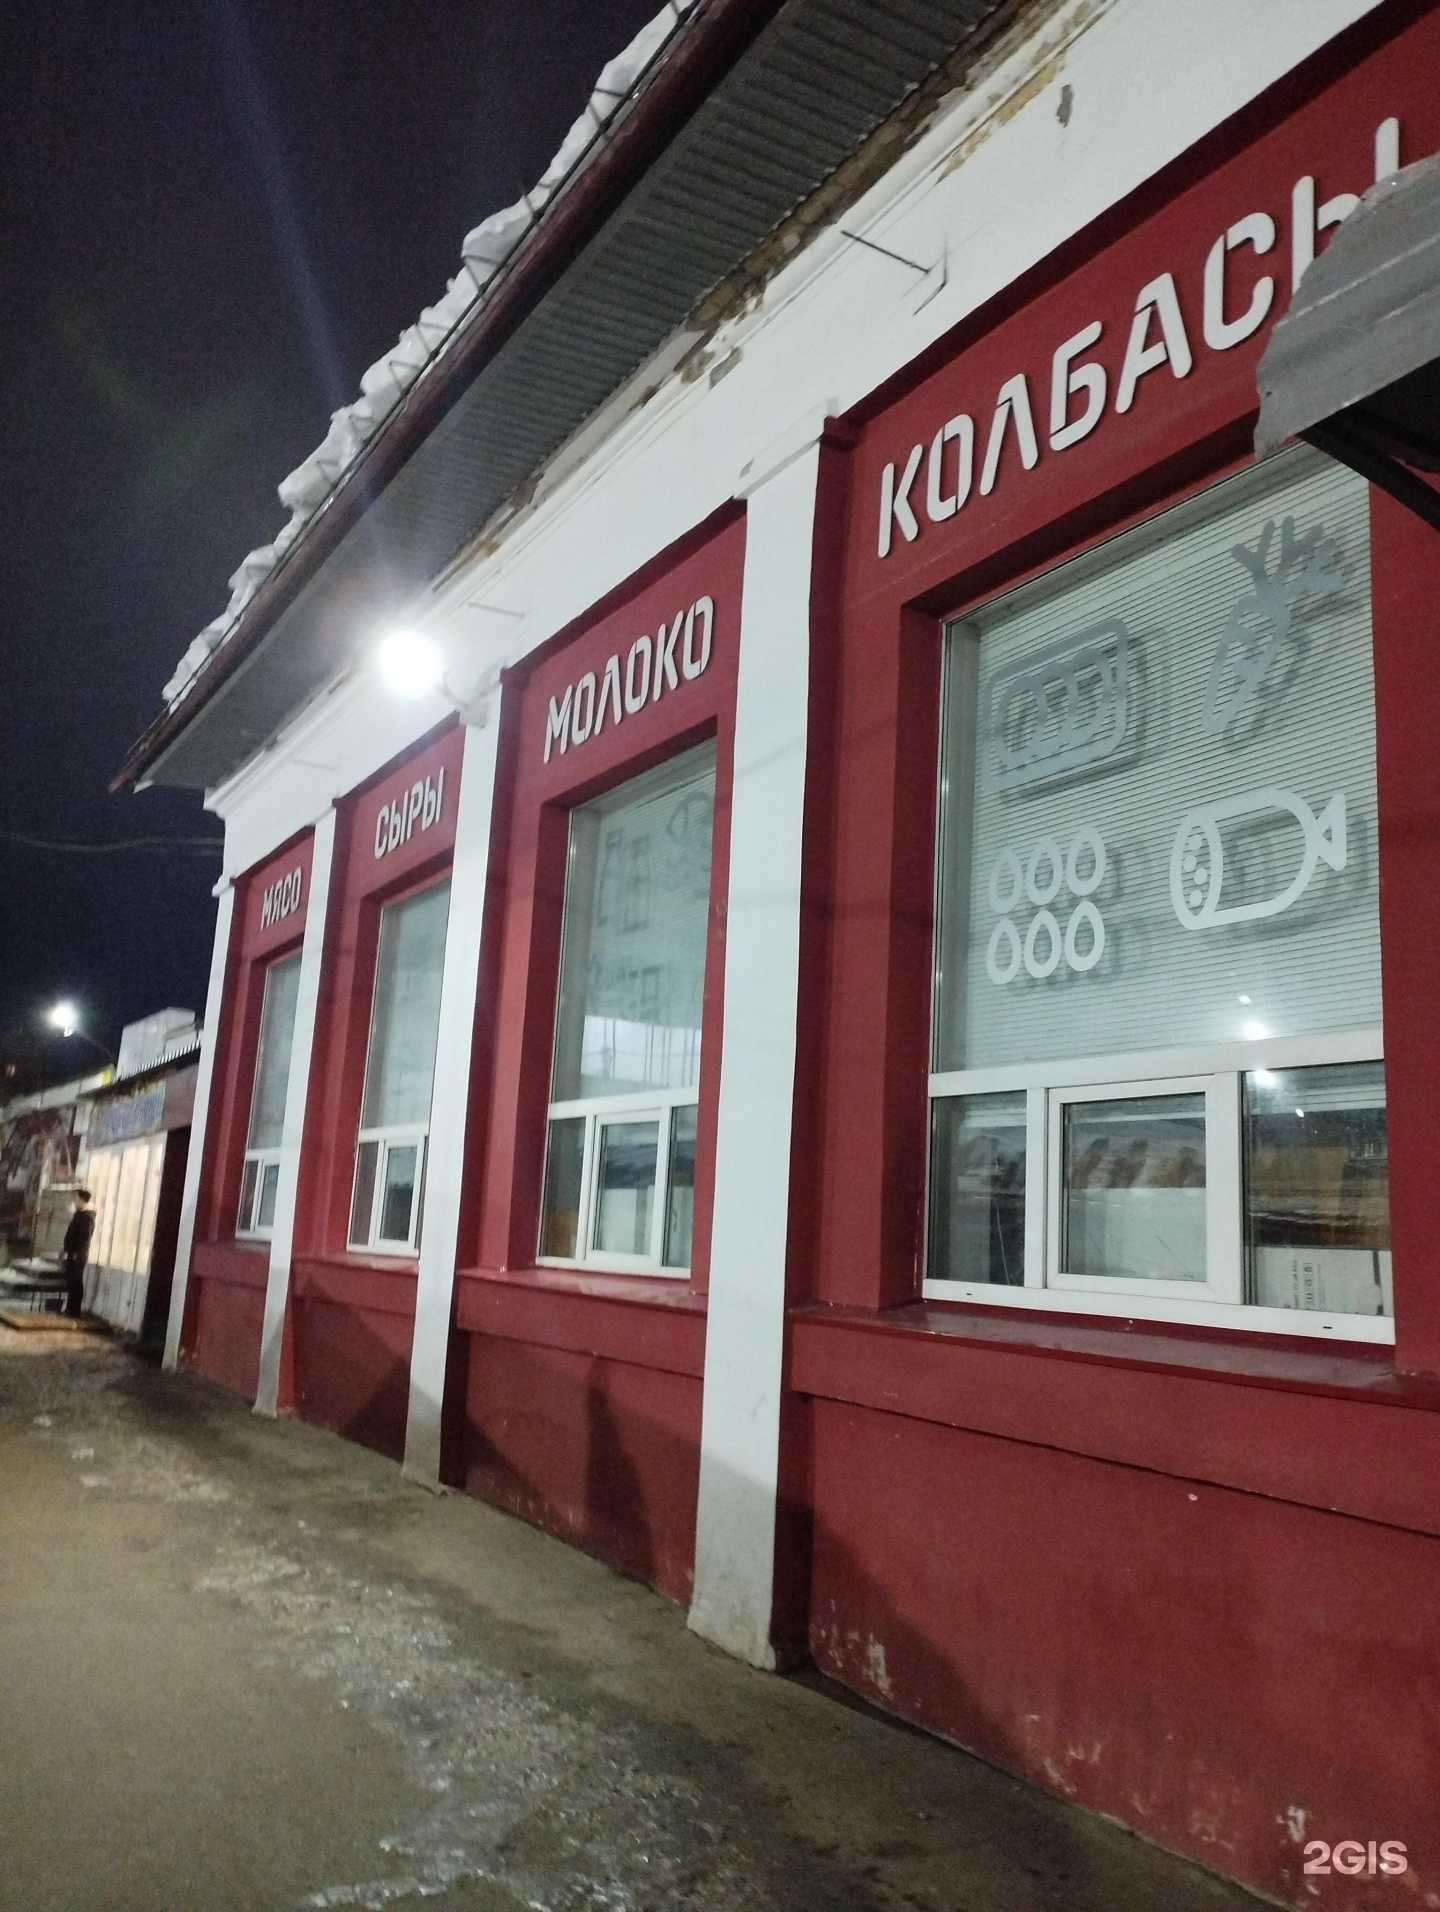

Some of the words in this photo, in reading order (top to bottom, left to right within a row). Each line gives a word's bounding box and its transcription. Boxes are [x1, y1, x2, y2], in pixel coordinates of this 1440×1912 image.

[543, 595, 714, 763] МОЛОКО
[374, 766, 446, 860] СЫРЫ
[260, 867, 302, 931] МЯСО
